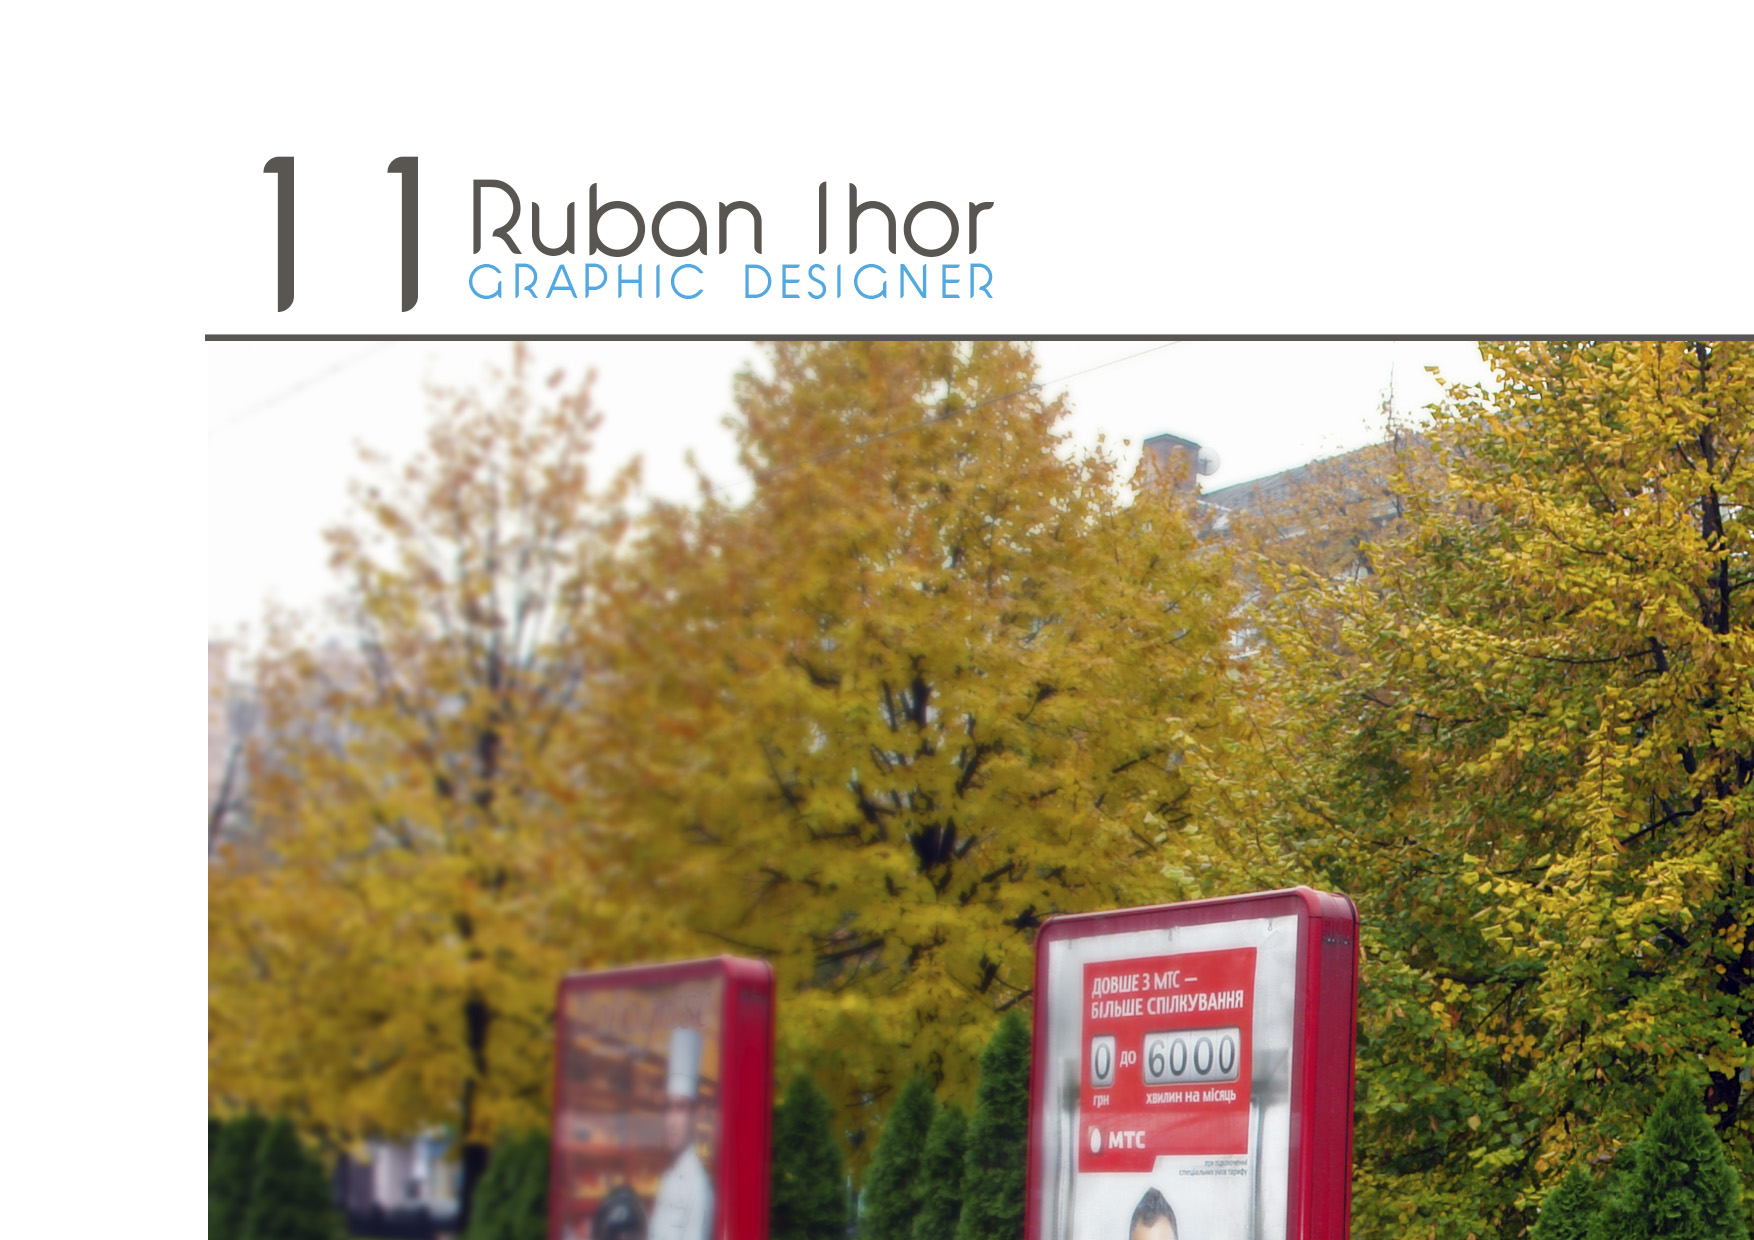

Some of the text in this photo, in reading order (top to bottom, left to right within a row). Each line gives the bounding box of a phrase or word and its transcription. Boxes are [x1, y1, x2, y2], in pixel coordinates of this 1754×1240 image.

[1092, 974, 1140, 999] ДОВШЕ
[1154, 970, 1180, 990] МТС
[1091, 990, 1244, 1019] БІЛЬШЕ СПІЛКУВАННЯ
[1095, 1042, 1110, 1080] 0
[1148, 1035, 1235, 1078] 6000
[1093, 1087, 1237, 1108] грн хвилин на місяць
[1109, 1130, 1146, 1149] МТС
